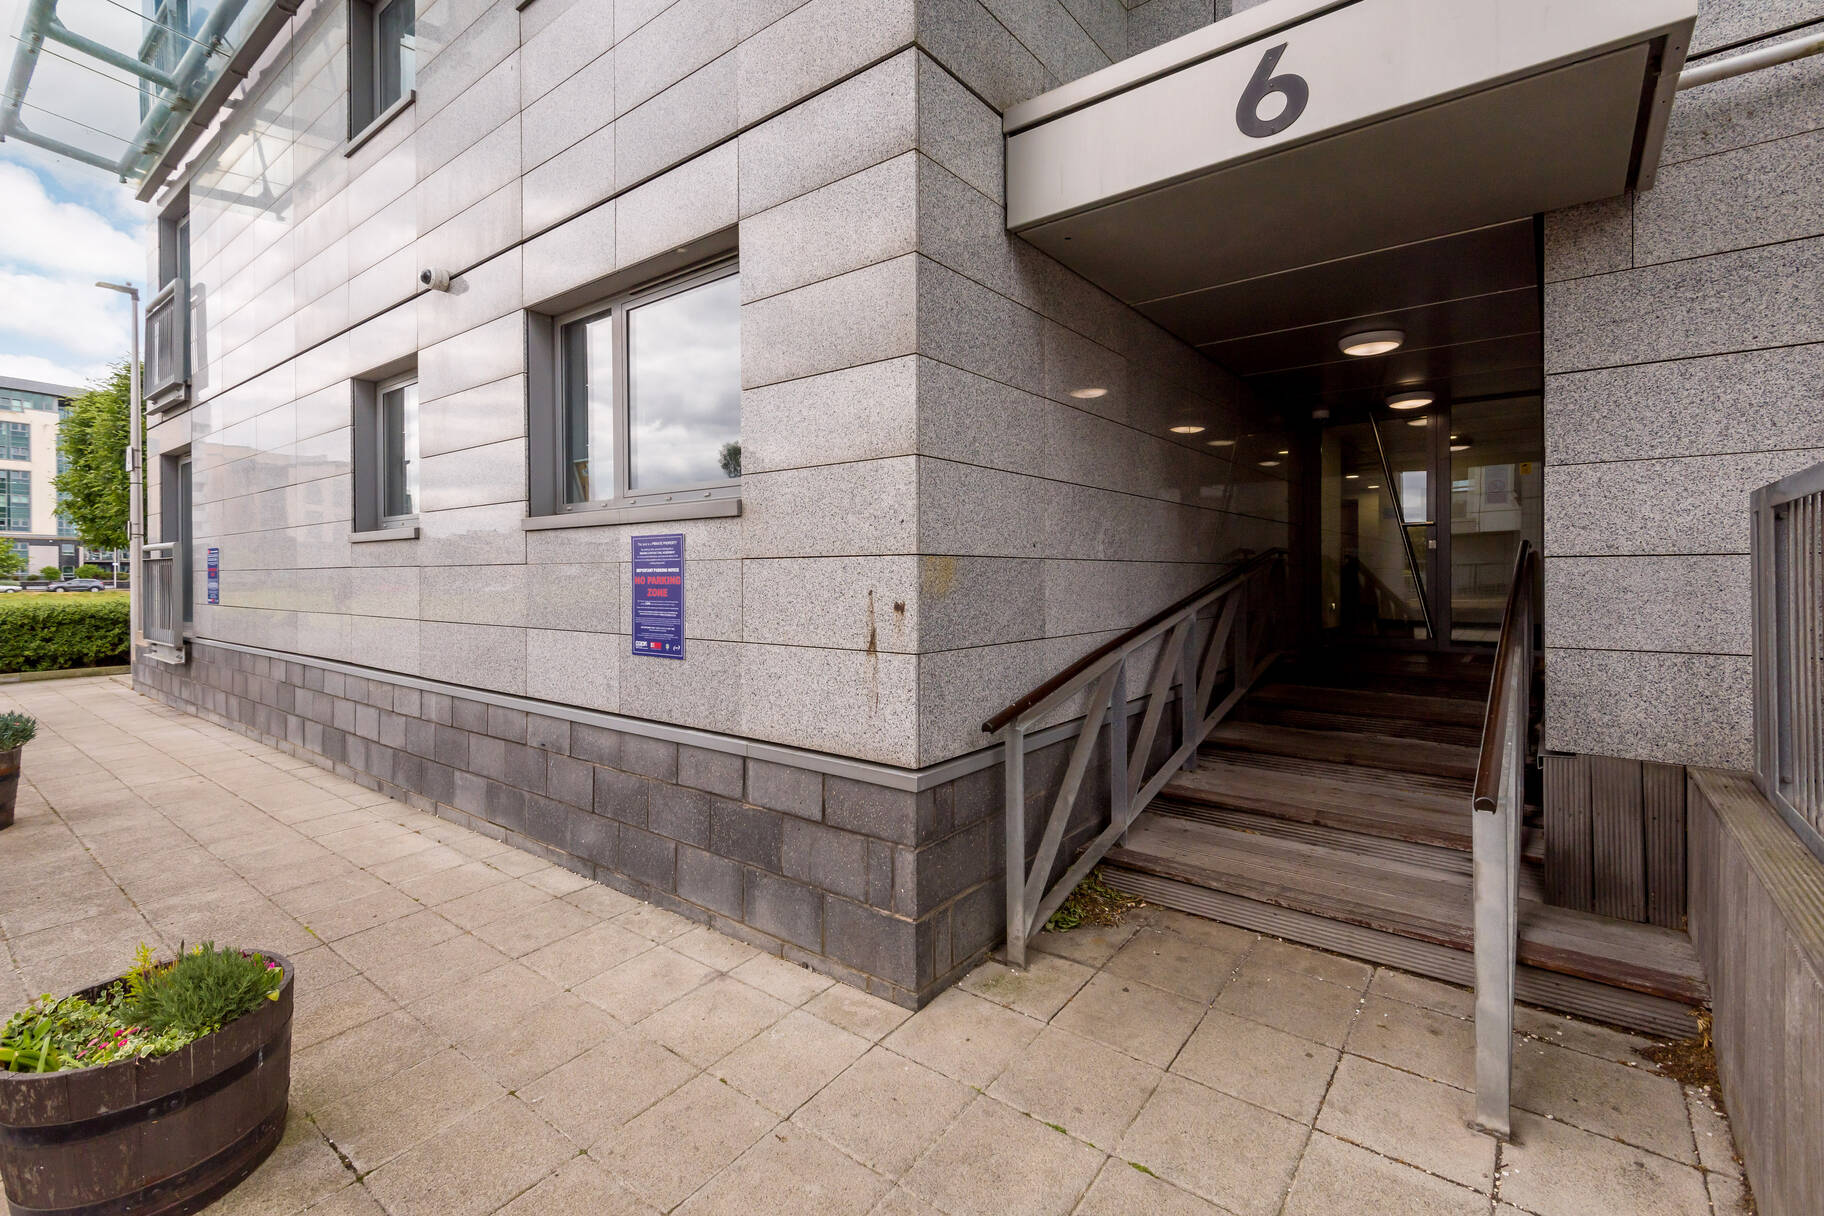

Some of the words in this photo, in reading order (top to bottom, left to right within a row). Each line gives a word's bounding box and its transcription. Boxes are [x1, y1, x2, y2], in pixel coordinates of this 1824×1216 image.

[1235, 41, 1309, 138] 6
[634, 576, 646, 585] NO
[647, 576, 681, 585] PARKING
[647, 588, 668, 597] ZONE
